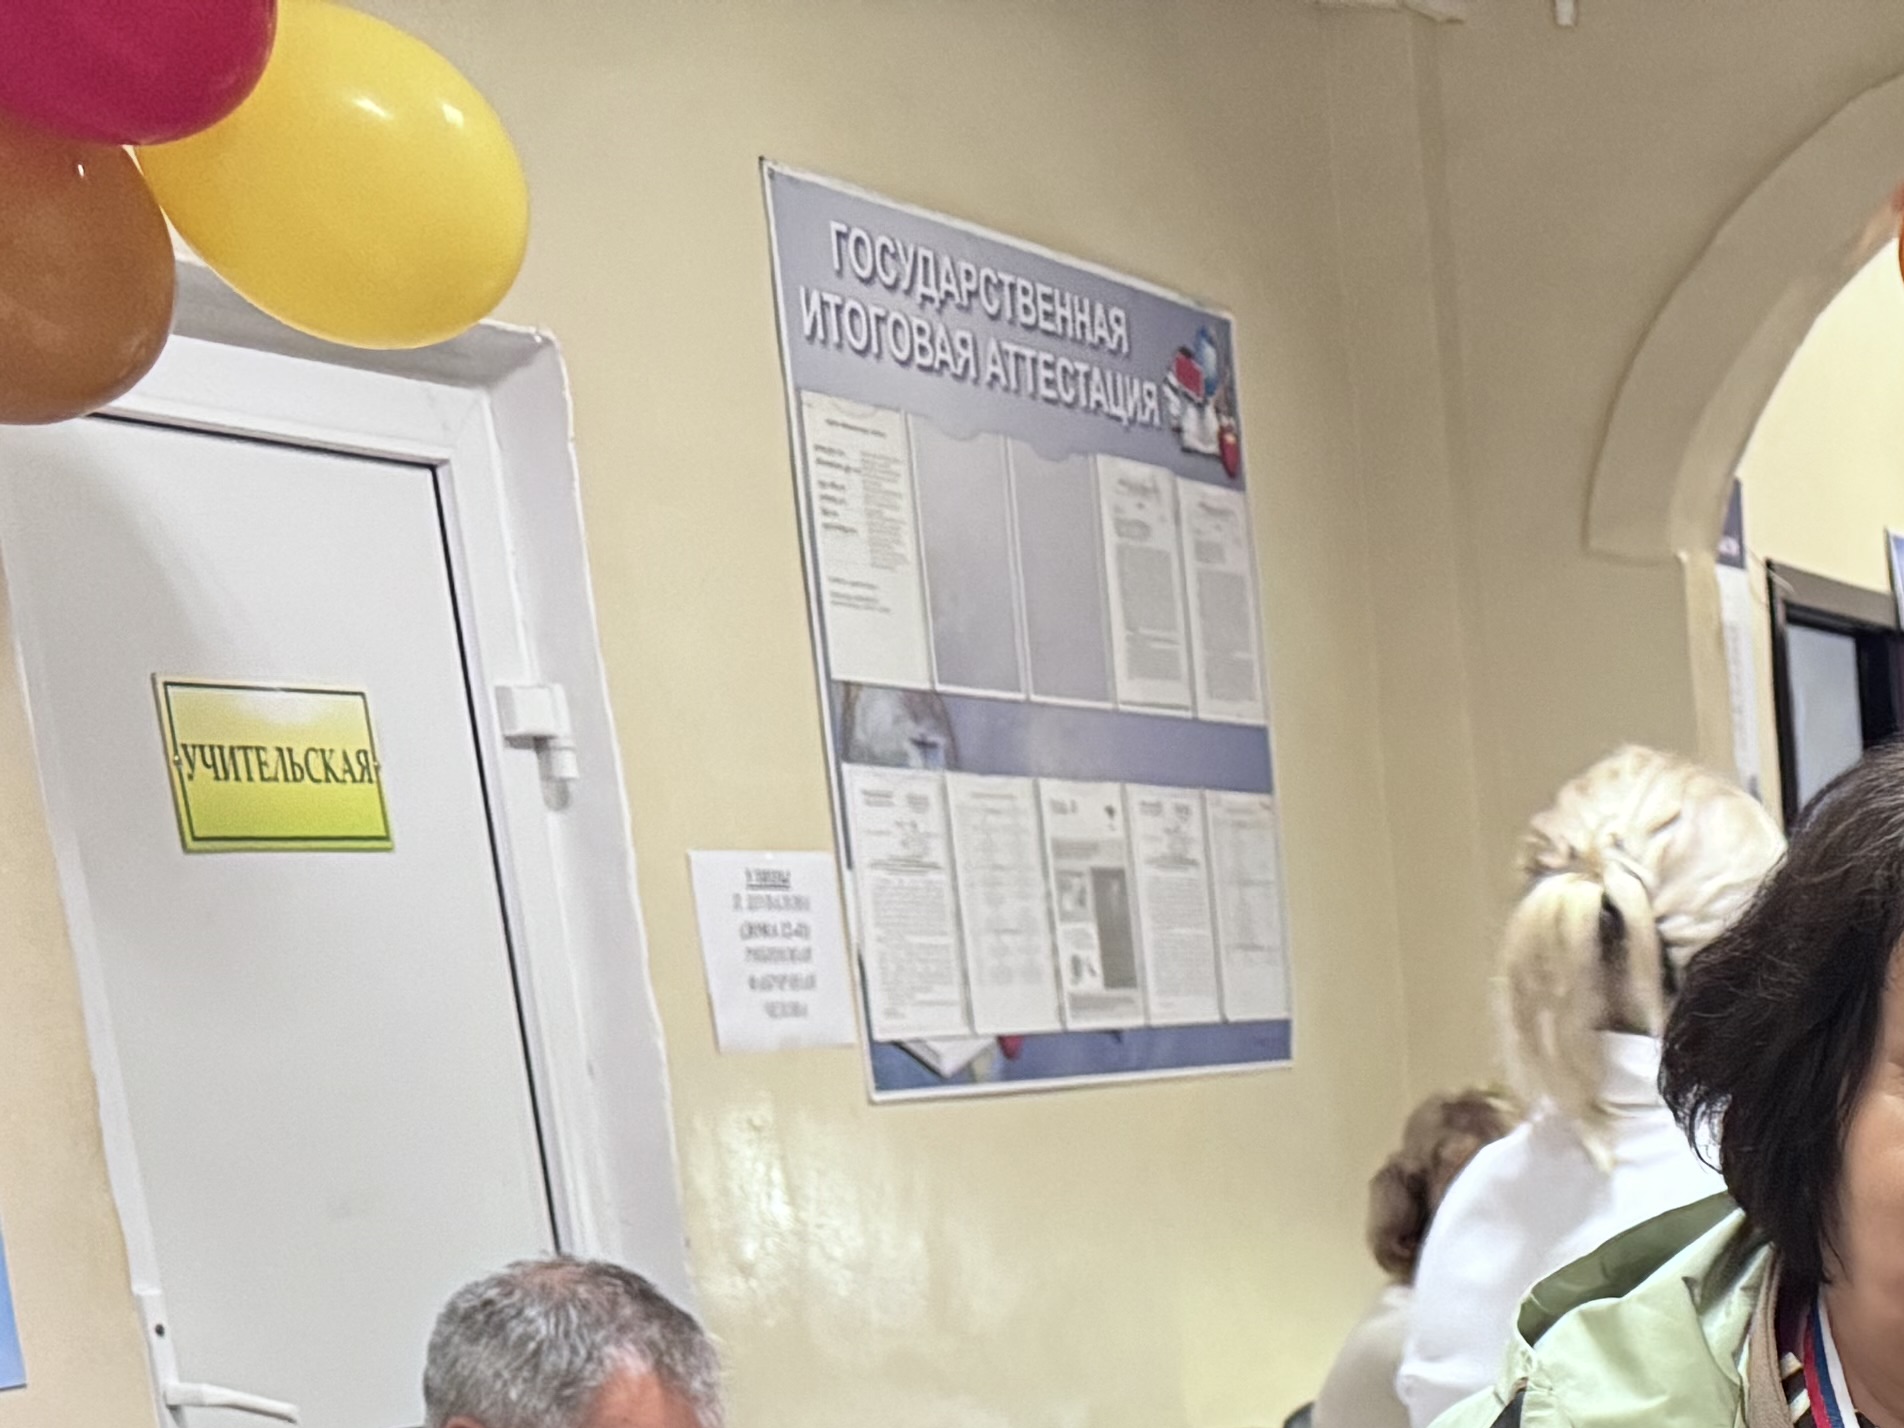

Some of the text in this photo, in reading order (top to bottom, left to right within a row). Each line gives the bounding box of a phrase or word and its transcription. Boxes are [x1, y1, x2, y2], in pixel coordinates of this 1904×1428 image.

[829, 221, 1130, 355] ГОСУДАРСТВЕННАЯ
[799, 286, 1160, 428] ИТОГОВАЯ АТТЕСТАЦИЯ
[180, 743, 377, 787] УЧИТЕЛЬСКАЯ
